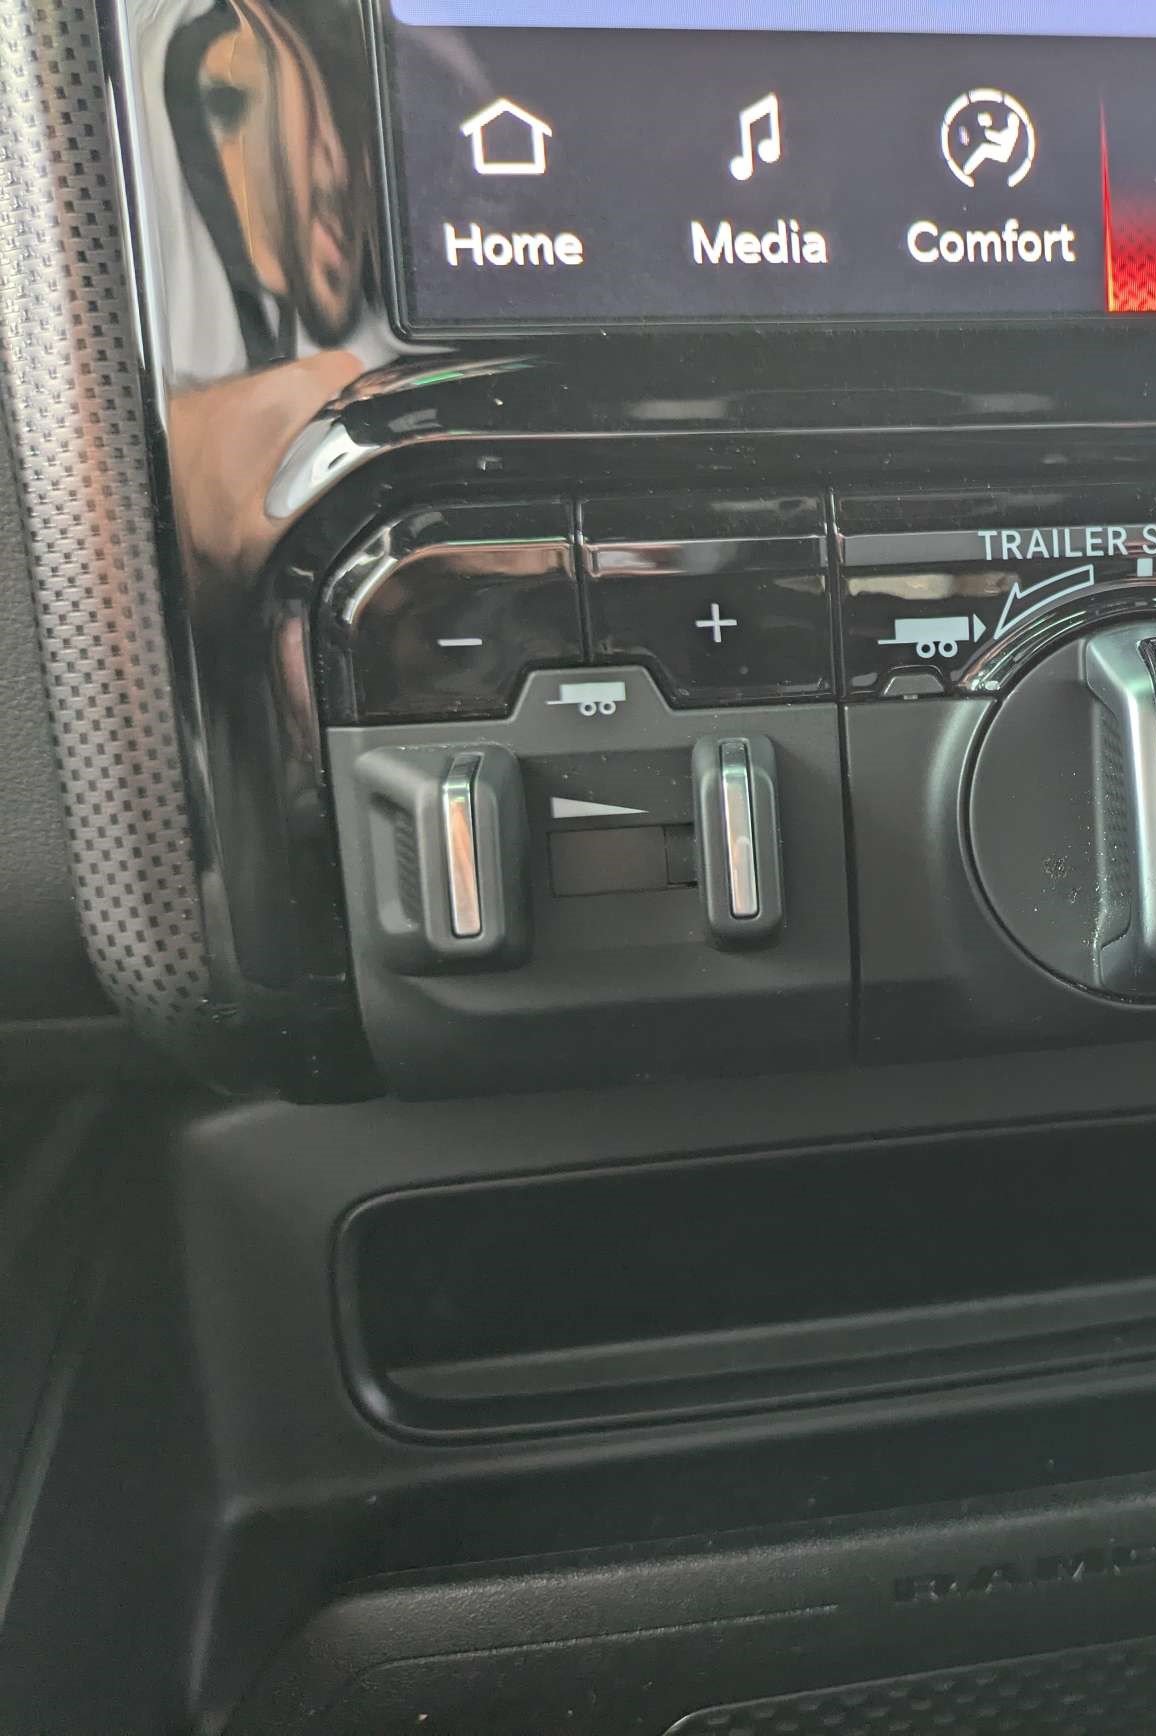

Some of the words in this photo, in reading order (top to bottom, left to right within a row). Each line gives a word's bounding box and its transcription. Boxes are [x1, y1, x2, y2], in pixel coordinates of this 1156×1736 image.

[443, 222, 584, 266] Home
[691, 219, 828, 265] Media
[906, 219, 1077, 265] Comfort
[977, 527, 1129, 561] TRAILER
